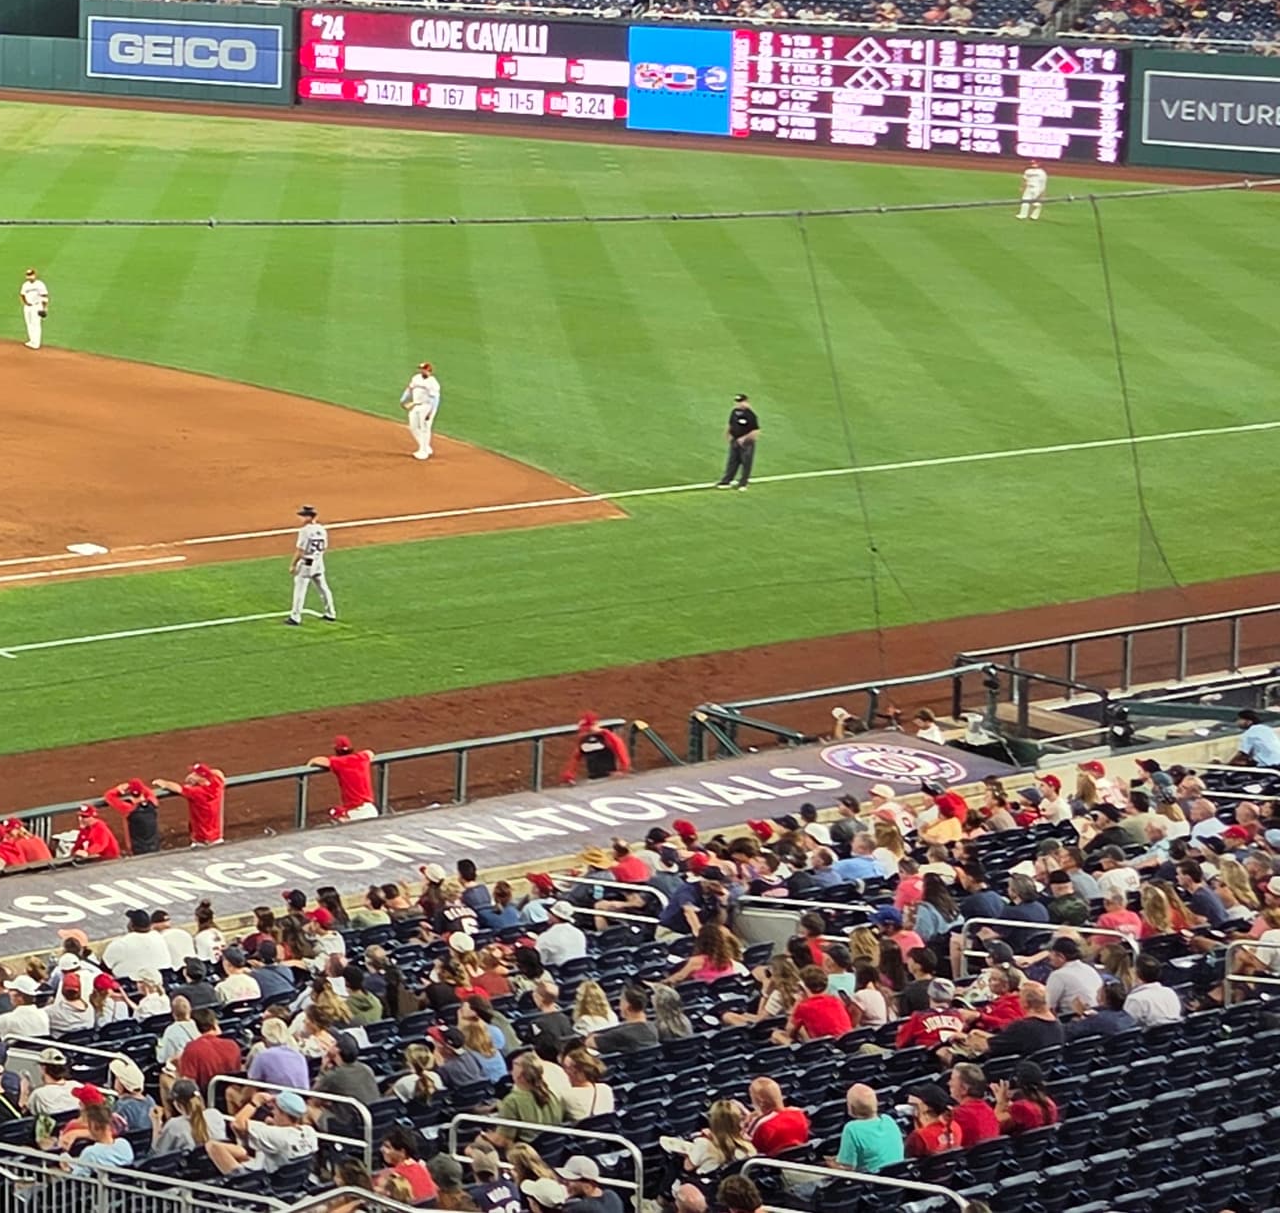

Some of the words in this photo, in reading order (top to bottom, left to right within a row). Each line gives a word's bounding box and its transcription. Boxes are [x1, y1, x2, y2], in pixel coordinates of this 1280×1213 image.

[108, 32, 257, 71] GEICO
[311, 14, 345, 42] #24
[410, 19, 463, 51] CADE
[466, 22, 548, 54] CAVALLI
[443, 87, 464, 106] 167
[509, 90, 534, 111] 11-5
[575, 96, 605, 115] 3.24
[424, 768, 843, 854] NATIONALS
